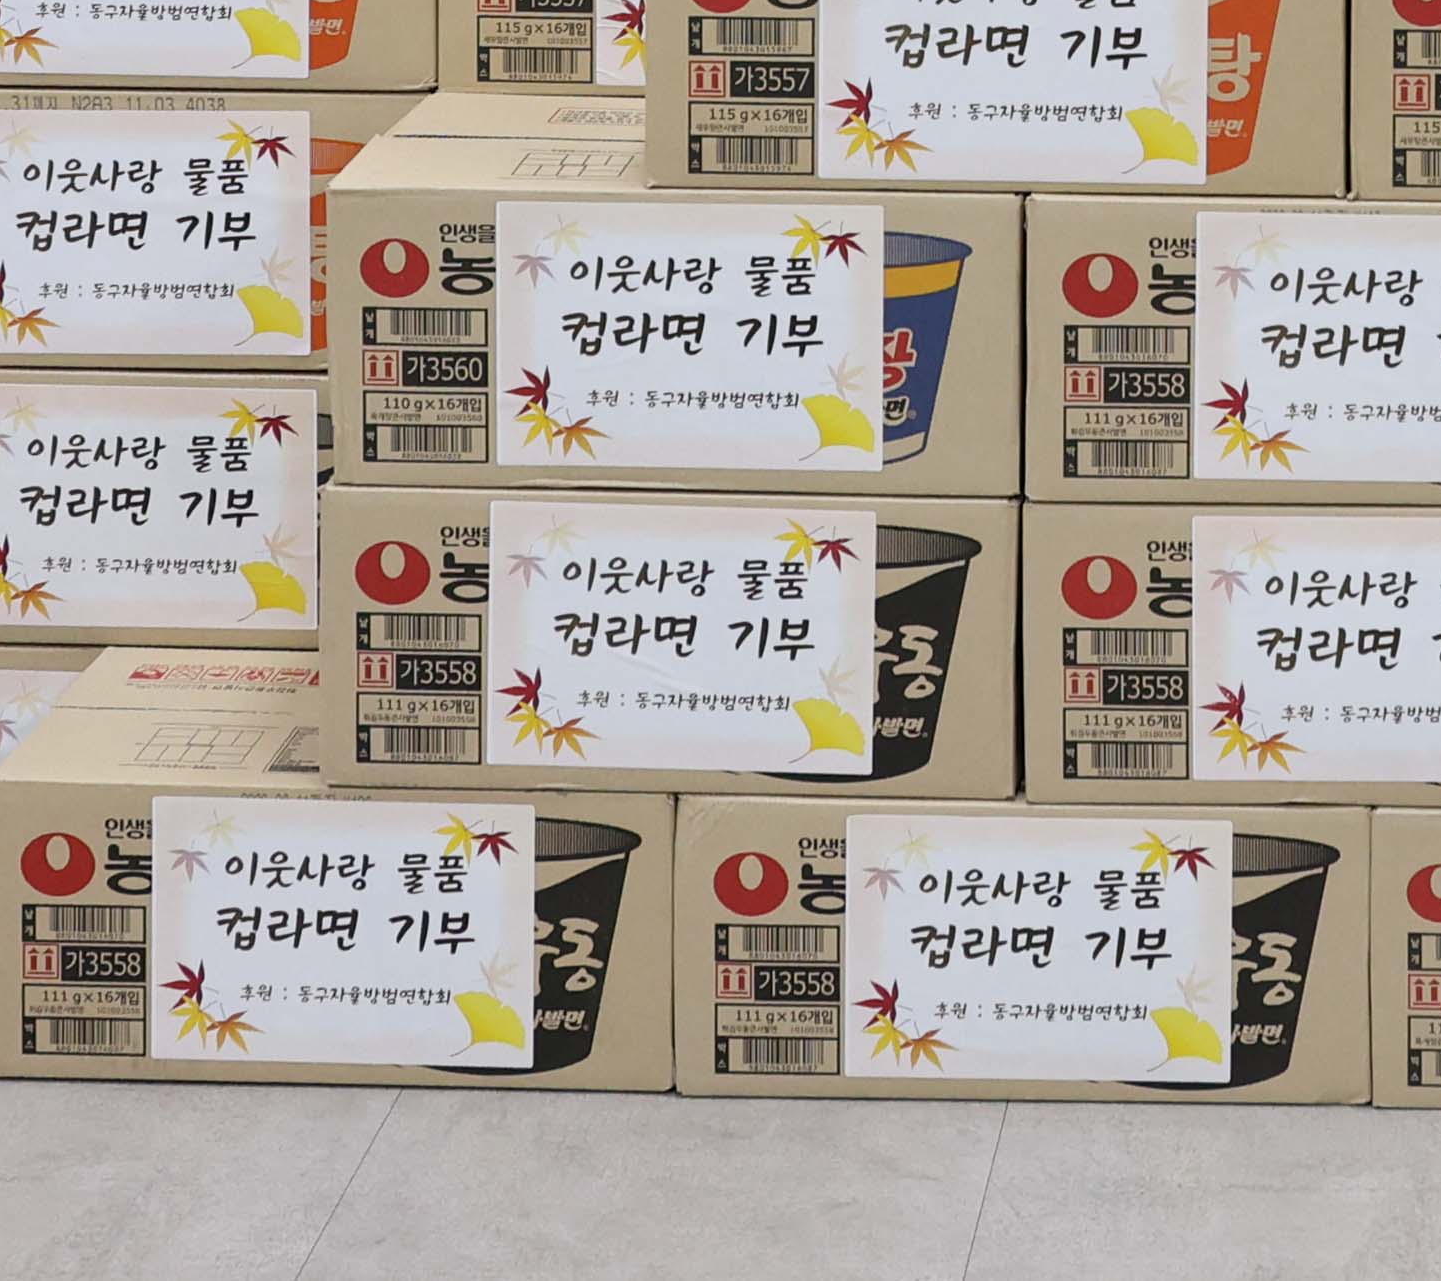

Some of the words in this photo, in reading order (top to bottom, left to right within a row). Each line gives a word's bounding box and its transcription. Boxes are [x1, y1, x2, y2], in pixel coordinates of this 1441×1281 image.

[885, 23, 1030, 69] 컵라면
[1060, 25, 1148, 71] 기부
[734, 65, 811, 93] 가3557
[909, 102, 942, 120] 후원
[968, 103, 1123, 123] 동구자율방범연합회
[23, 158, 163, 194] 이웃사랑
[183, 158, 248, 197] 물품
[16, 210, 148, 252] 컵라면
[176, 211, 256, 252] 기부
[439, 223, 495, 243] 인생을
[570, 255, 722, 295] 이웃사랑
[745, 256, 816, 297] 물품
[1270, 267, 1424, 307] 이웃사랑
[562, 311, 706, 357] 컵라면
[736, 313, 824, 358] 기부
[1261, 323, 1406, 369] 컵라면
[407, 355, 483, 383] 가3560
[587, 389, 619, 407] 후원
[645, 390, 800, 410] 동구자율방범연합회
[27, 434, 166, 471] 이웃사랑
[186, 435, 252, 473] 물품
[20, 485, 151, 527] 컵라면
[179, 487, 259, 528] 기부
[42, 556, 72, 573] 후원
[95, 557, 237, 576] 동구자율방범연합회
[563, 556, 715, 597] 이웃사랑
[737, 559, 808, 601] 물품
[1265, 570, 1418, 609] 이웃사랑
[554, 612, 698, 658] 컵라면
[728, 617, 815, 661] 기부
[1257, 626, 1401, 672] 컵라면
[1107, 673, 1184, 702] 가3558
[225, 851, 375, 891] 이웃사랑
[397, 853, 468, 895] 물품
[919, 868, 1071, 908] 이웃사랑
[1094, 870, 1165, 911] 물품
[216, 906, 359, 952] 컵라면
[389, 910, 475, 955] 기부
[910, 924, 1055, 969] 컵라면
[1085, 926, 1172, 971] 기부
[65, 949, 142, 978] 가3558
